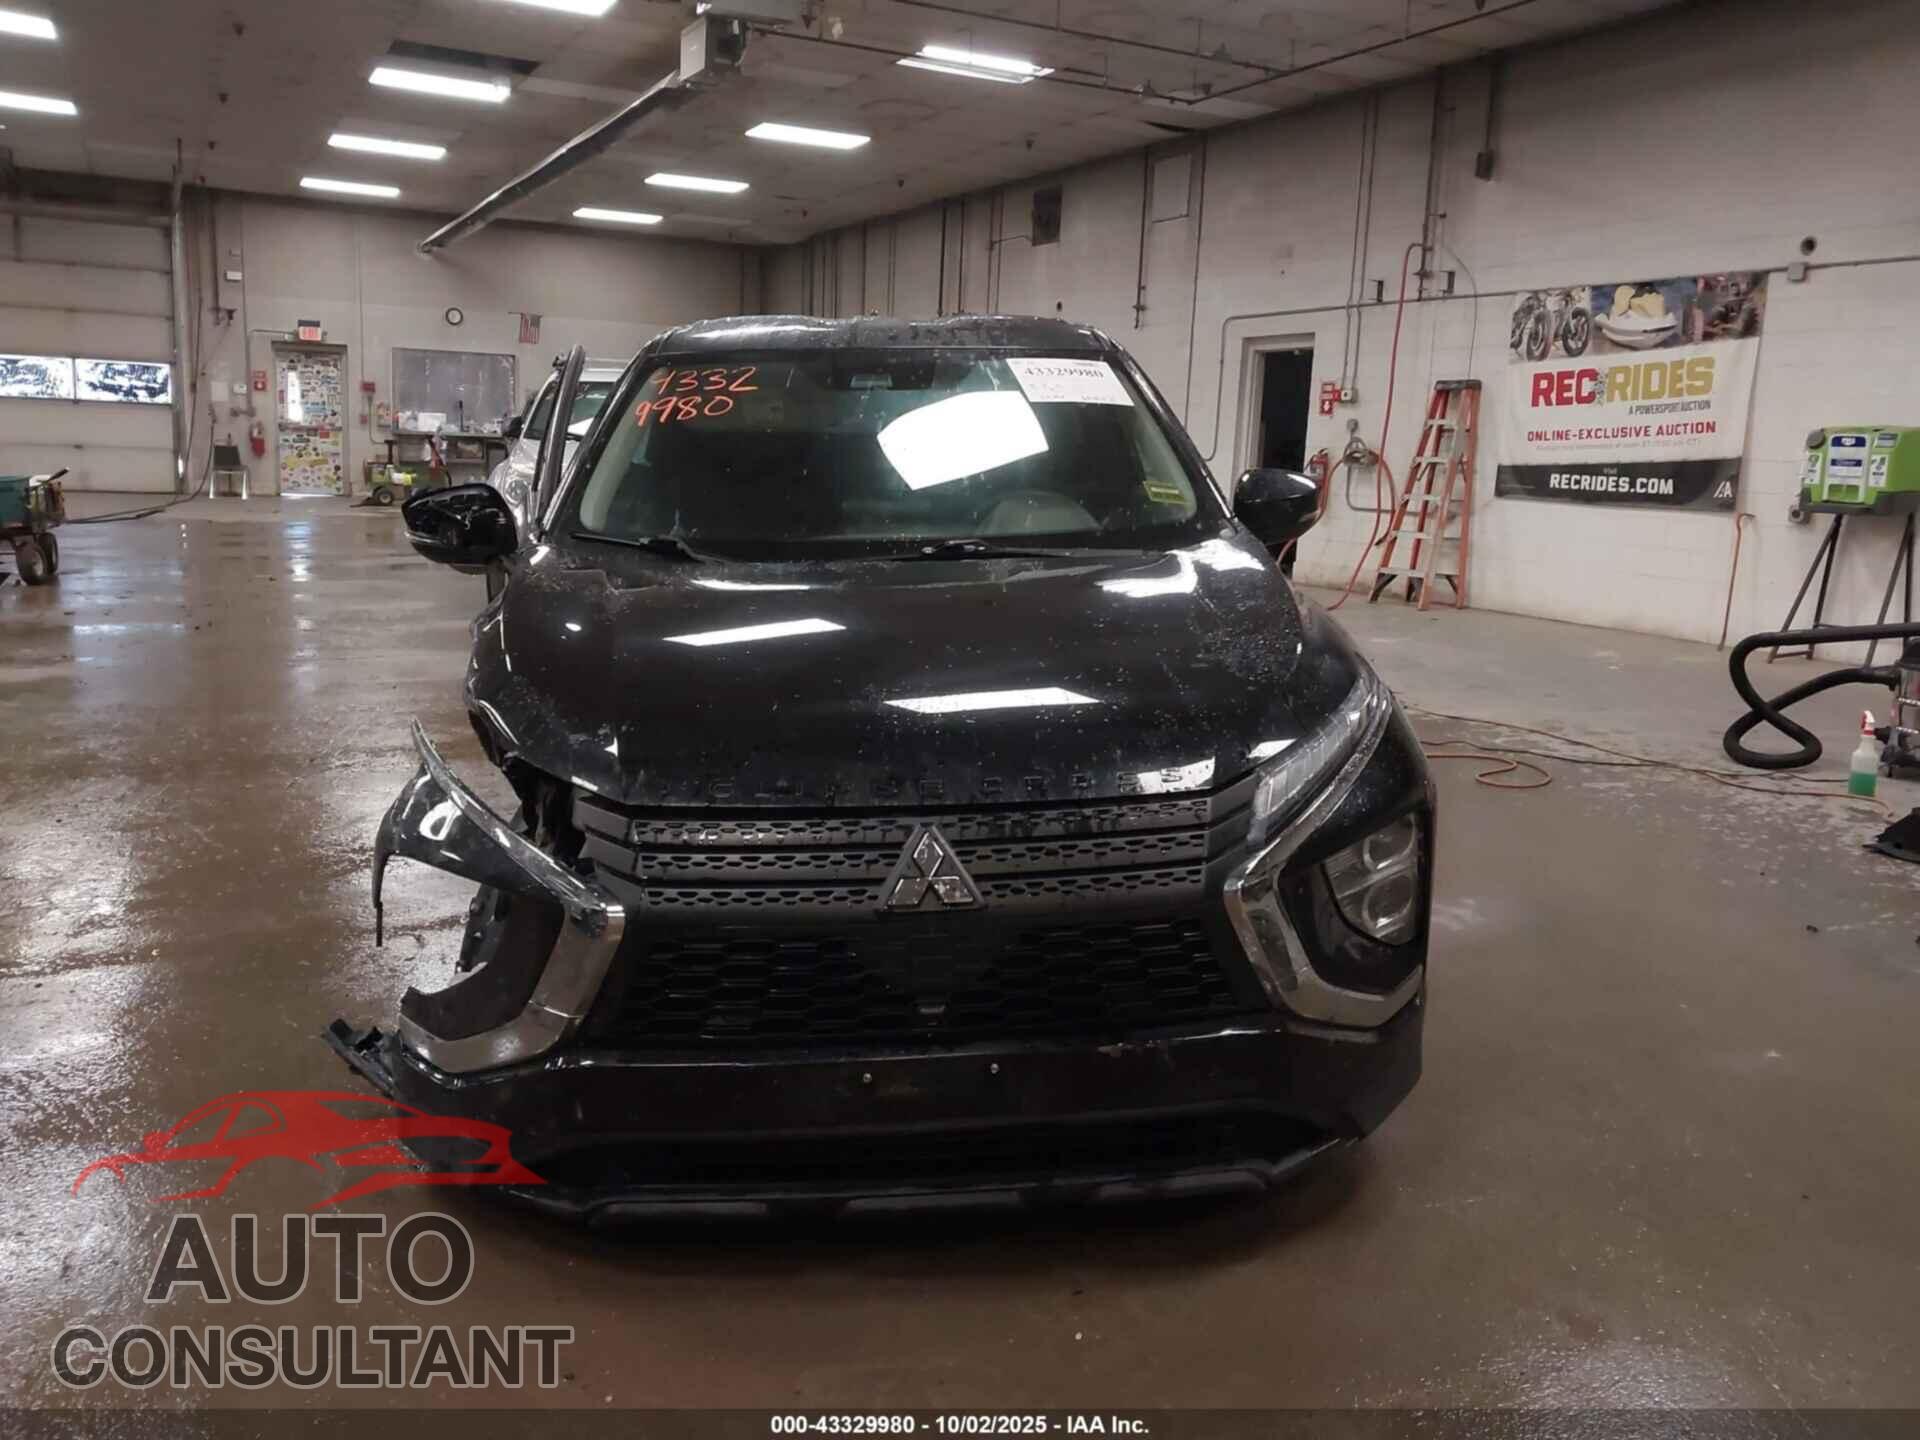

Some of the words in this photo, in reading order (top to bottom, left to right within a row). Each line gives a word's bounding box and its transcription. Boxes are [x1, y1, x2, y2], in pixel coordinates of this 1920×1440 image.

[1024, 367, 1104, 378] 43329980
[1531, 368, 1599, 407] REC
[1606, 357, 1715, 402] RIDES
[635, 395, 733, 426] 9980
[1527, 425, 1651, 442] ONLINE-EXCLUSIVE
[1656, 421, 1716, 436] AUCTION
[1549, 473, 1674, 495] RECRIDES.COM
